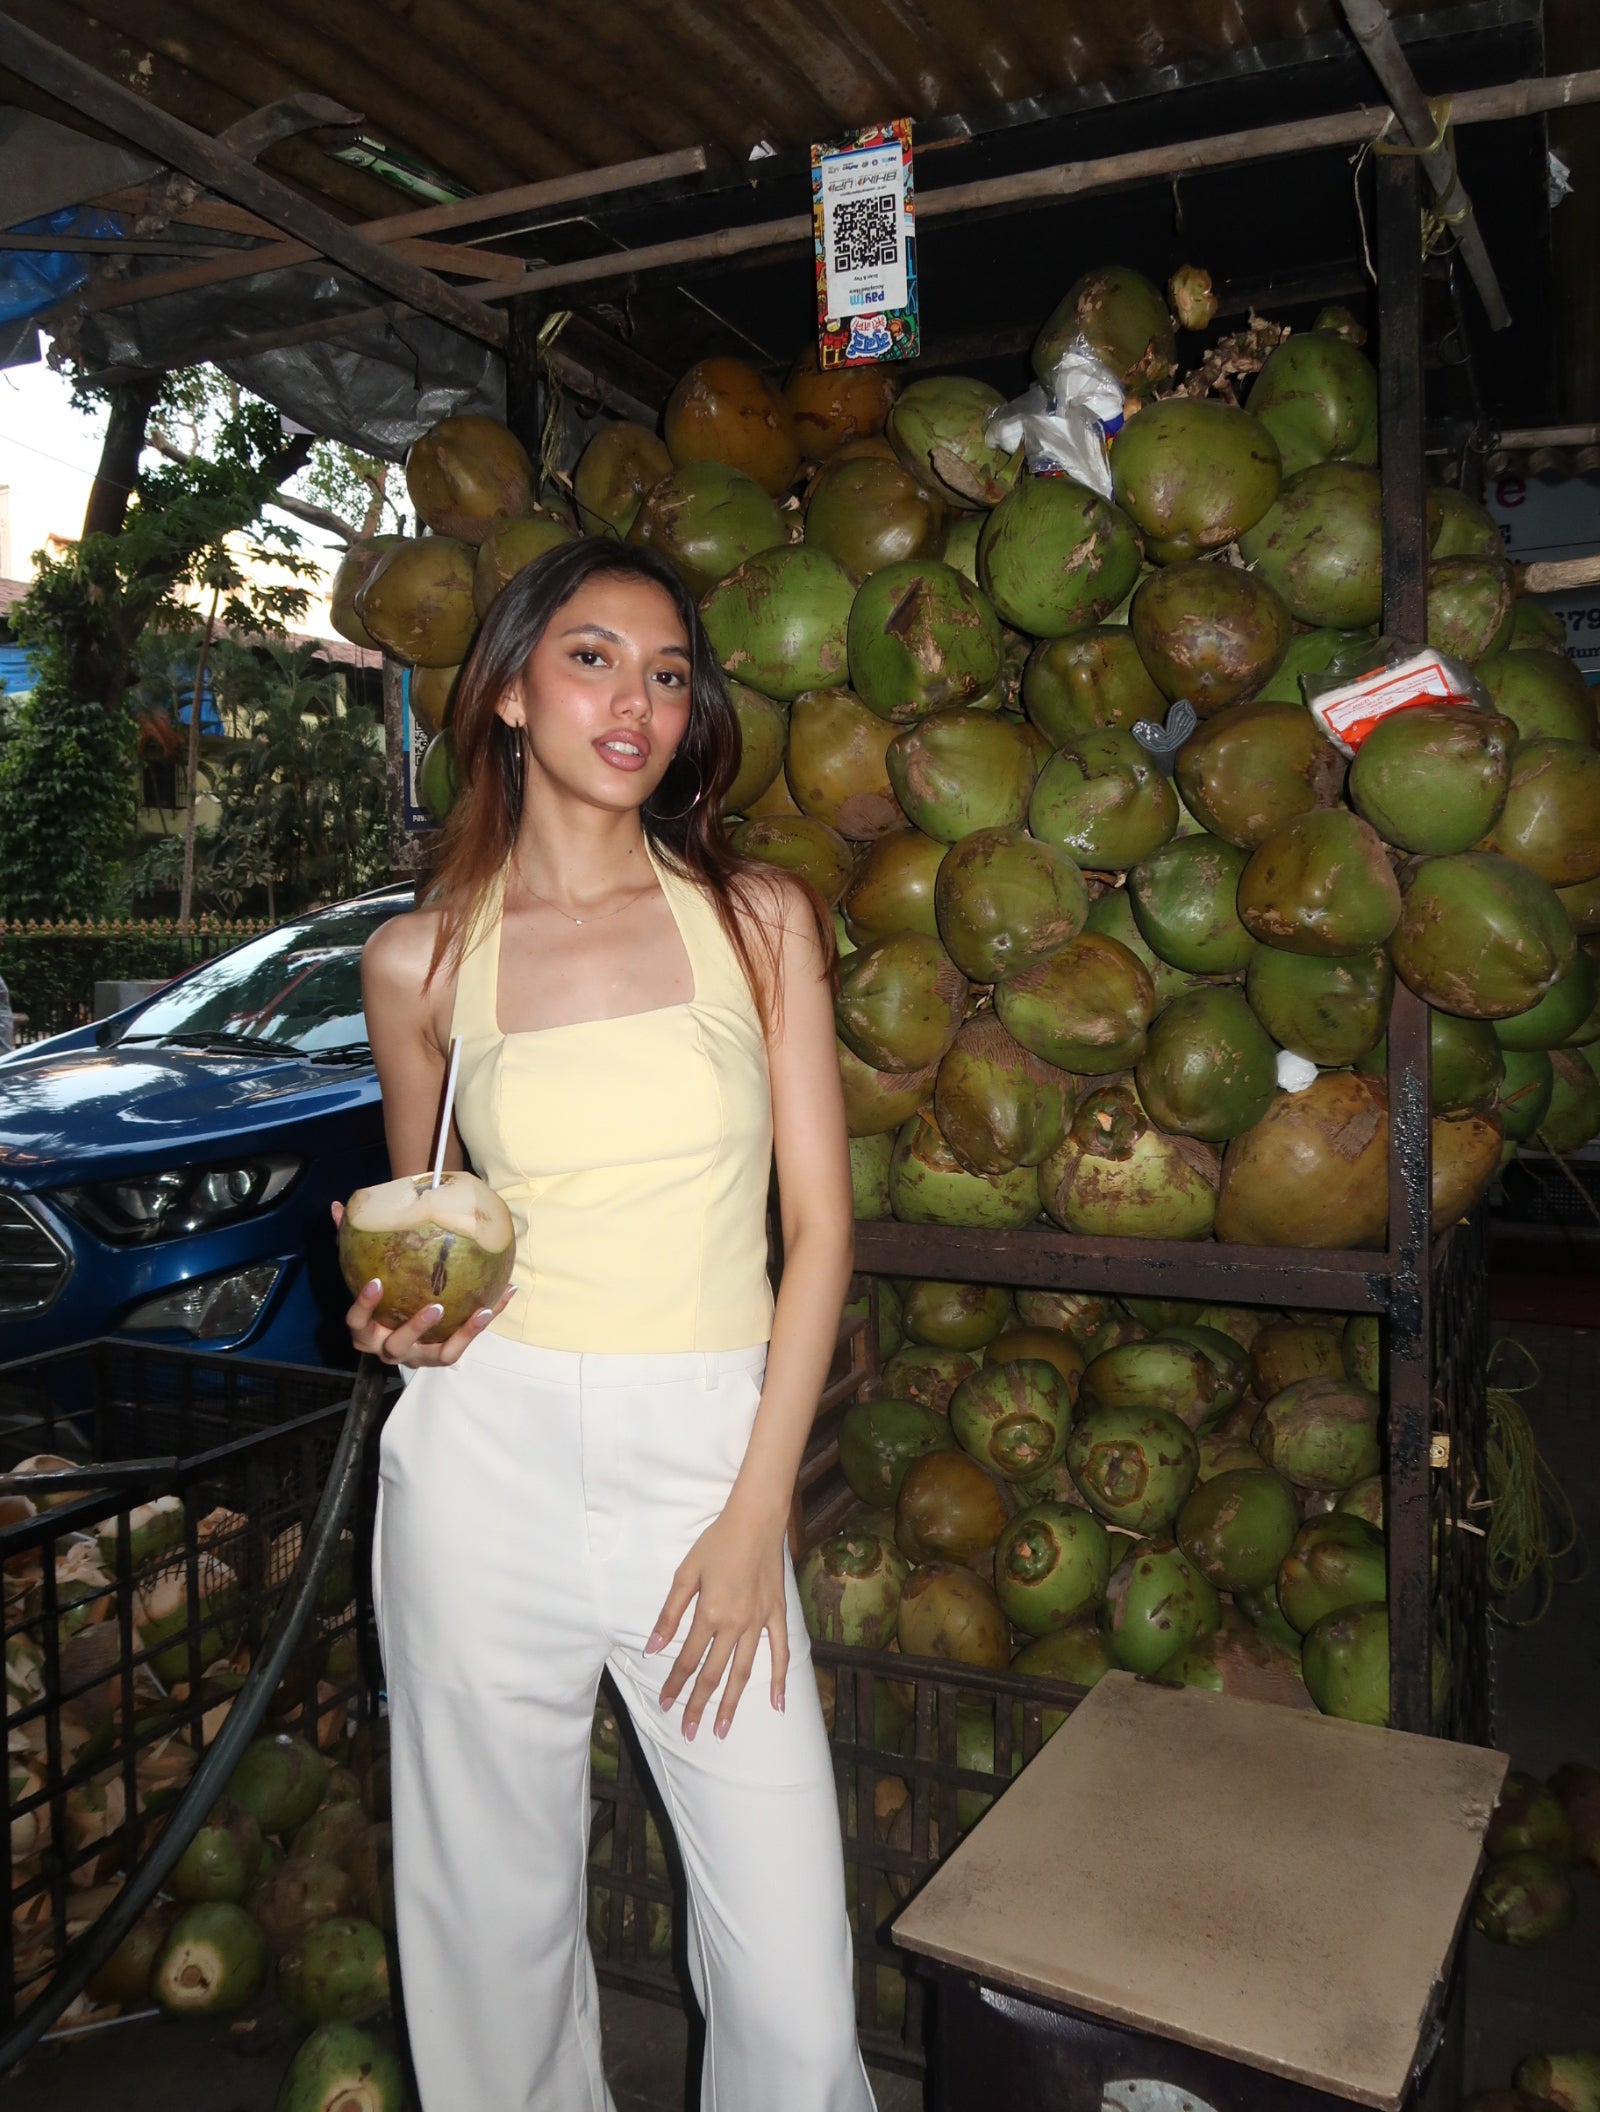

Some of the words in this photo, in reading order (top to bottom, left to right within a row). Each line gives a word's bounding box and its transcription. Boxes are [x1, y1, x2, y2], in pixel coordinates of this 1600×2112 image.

[863, 171, 897, 185] BHIM
[832, 180, 854, 192] UPI
[862, 285, 885, 294] Accepted
[847, 329, 891, 357] मुंबई
